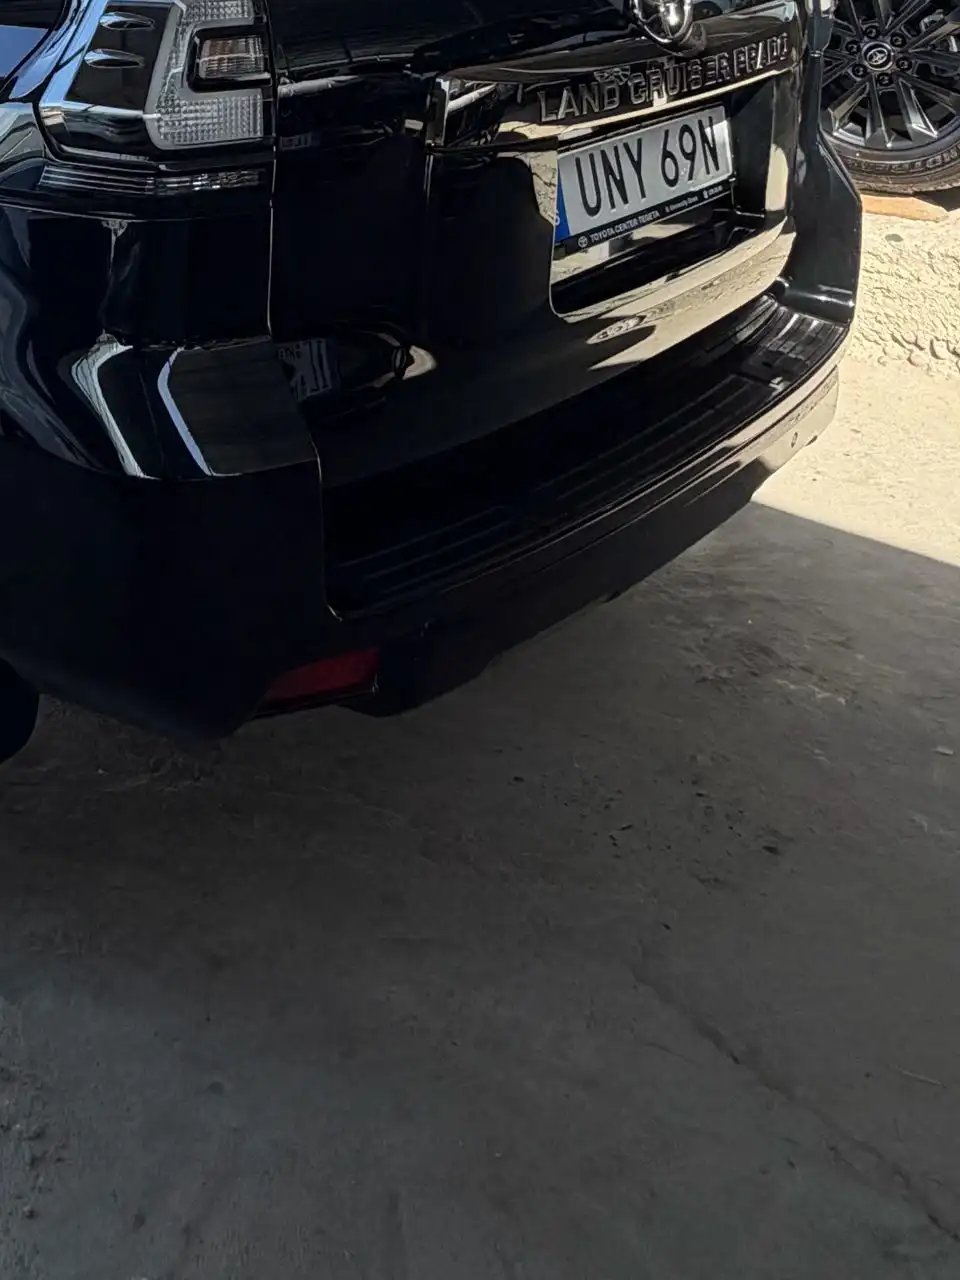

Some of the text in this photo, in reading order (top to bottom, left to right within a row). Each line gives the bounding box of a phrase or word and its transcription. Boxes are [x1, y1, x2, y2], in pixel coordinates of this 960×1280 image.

[537, 32, 789, 122] LAND CRUISER PRADO
[574, 115, 720, 218] UNY 69N
[590, 228, 614, 244] TOYOTA
